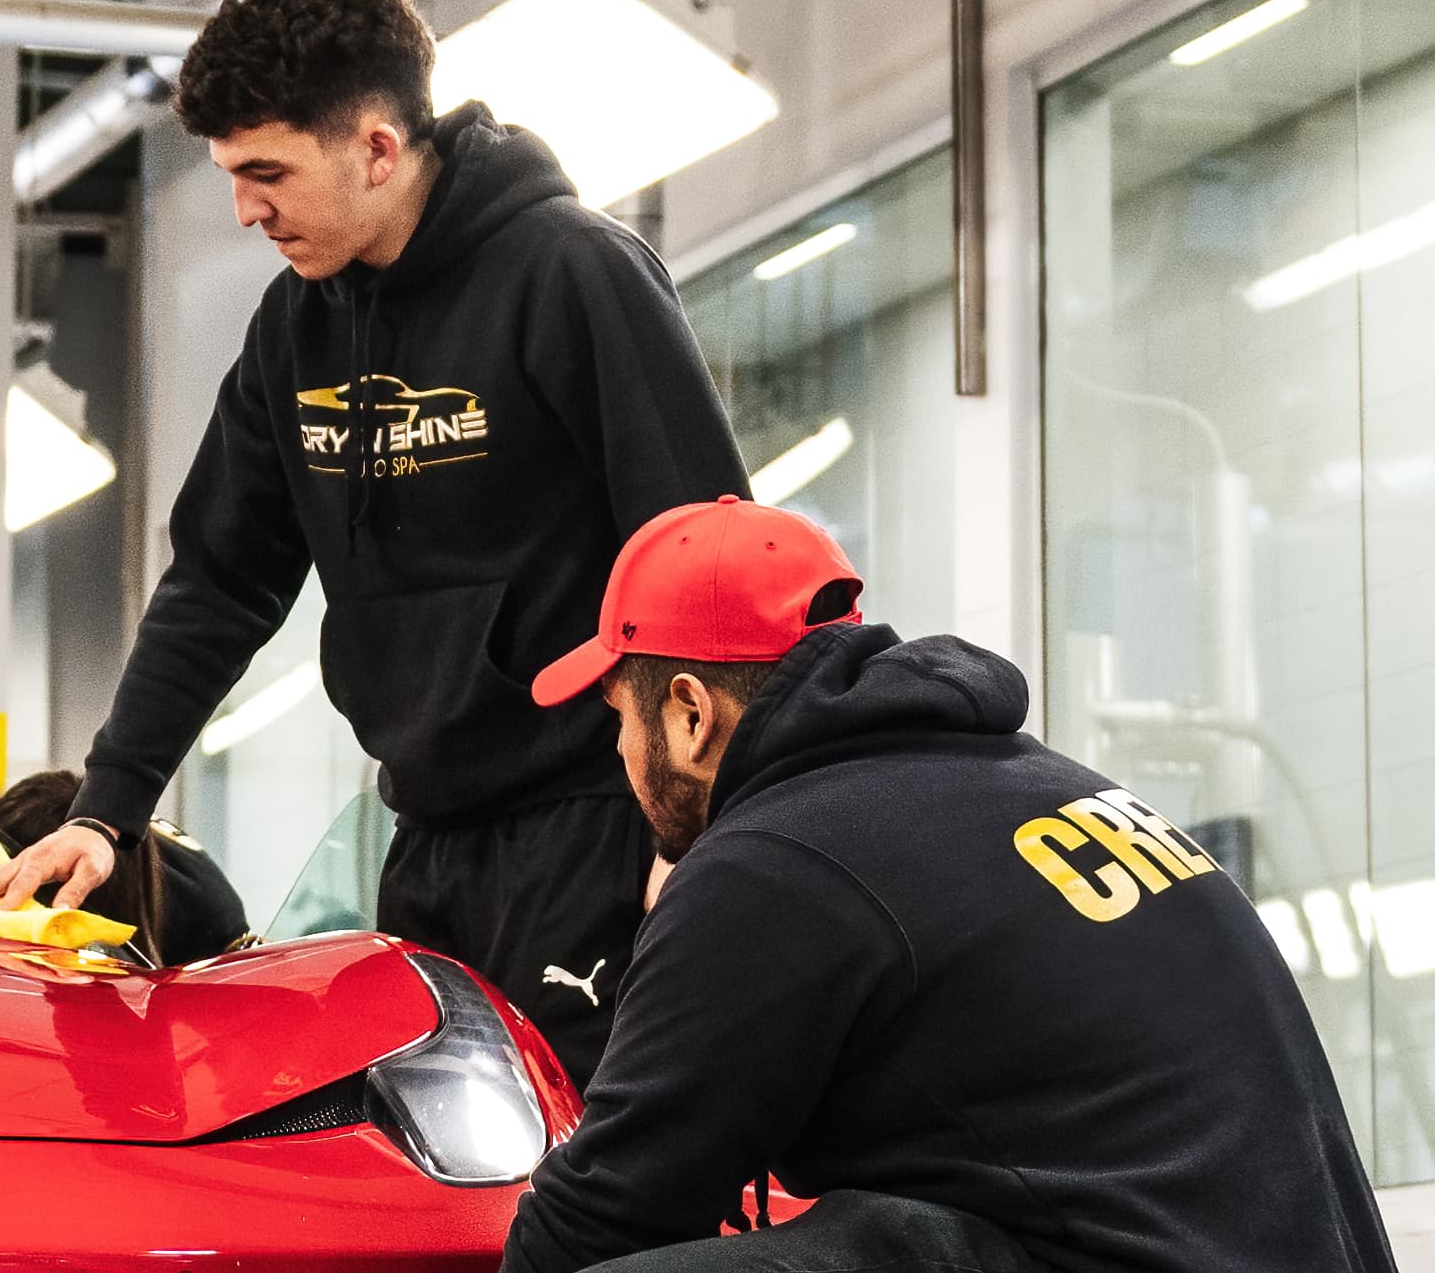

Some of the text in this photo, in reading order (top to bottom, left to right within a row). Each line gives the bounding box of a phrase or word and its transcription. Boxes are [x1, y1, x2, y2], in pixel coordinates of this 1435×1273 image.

[388, 409, 488, 452] SHINE
[392, 455, 421, 477] SPA
[1013, 788, 1226, 923] CRE
